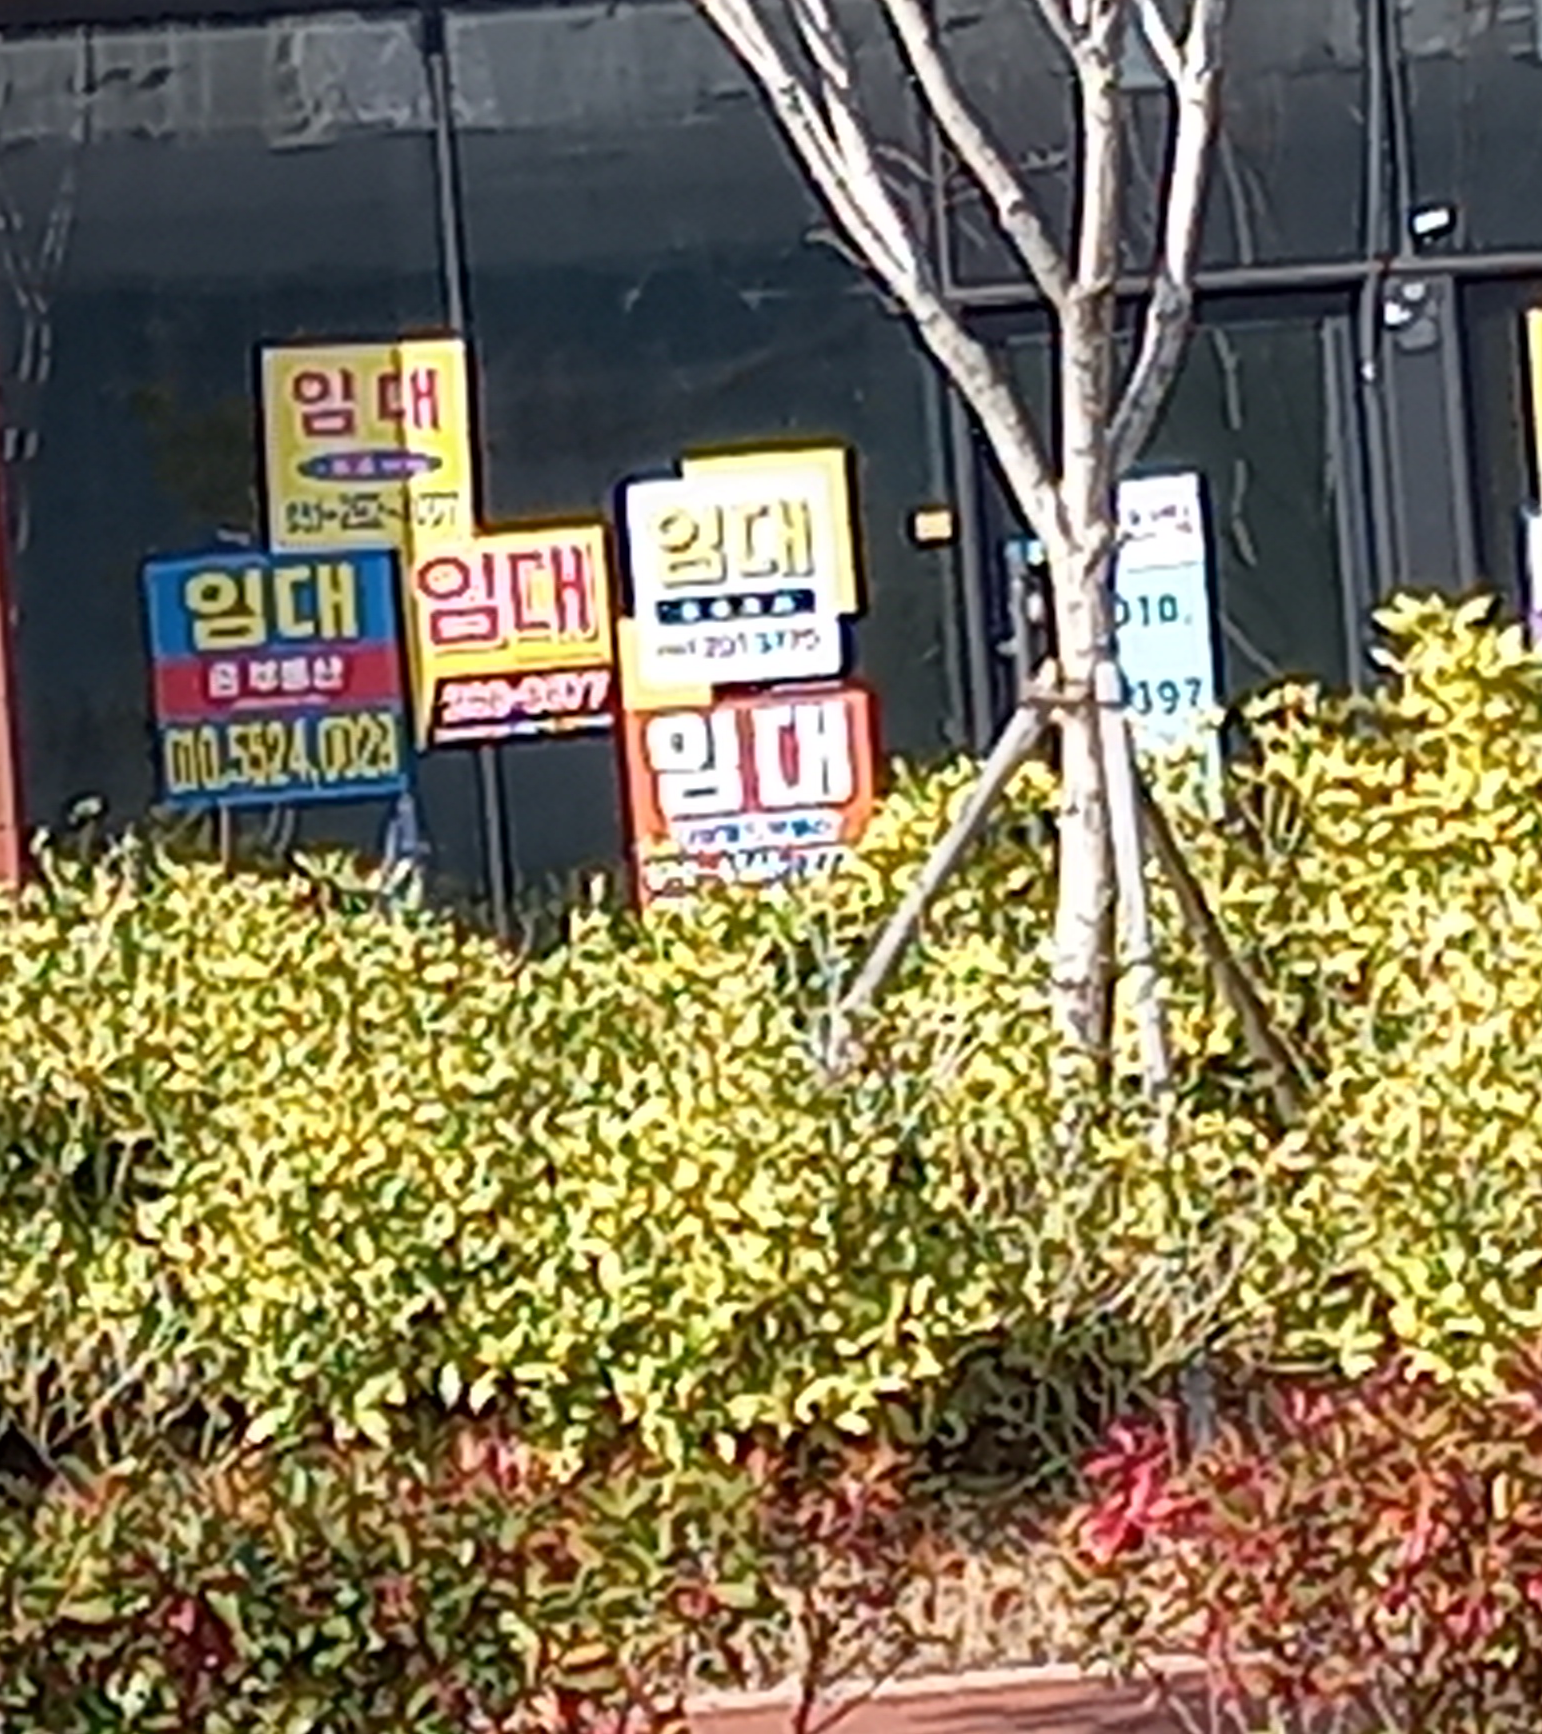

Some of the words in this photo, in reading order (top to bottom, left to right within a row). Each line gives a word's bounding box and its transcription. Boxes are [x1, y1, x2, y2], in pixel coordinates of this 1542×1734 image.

[292, 368, 441, 438] 임대
[653, 498, 817, 591] 임대
[185, 562, 357, 651] 임대
[416, 544, 597, 650] 임대
[645, 702, 854, 816] 임대
